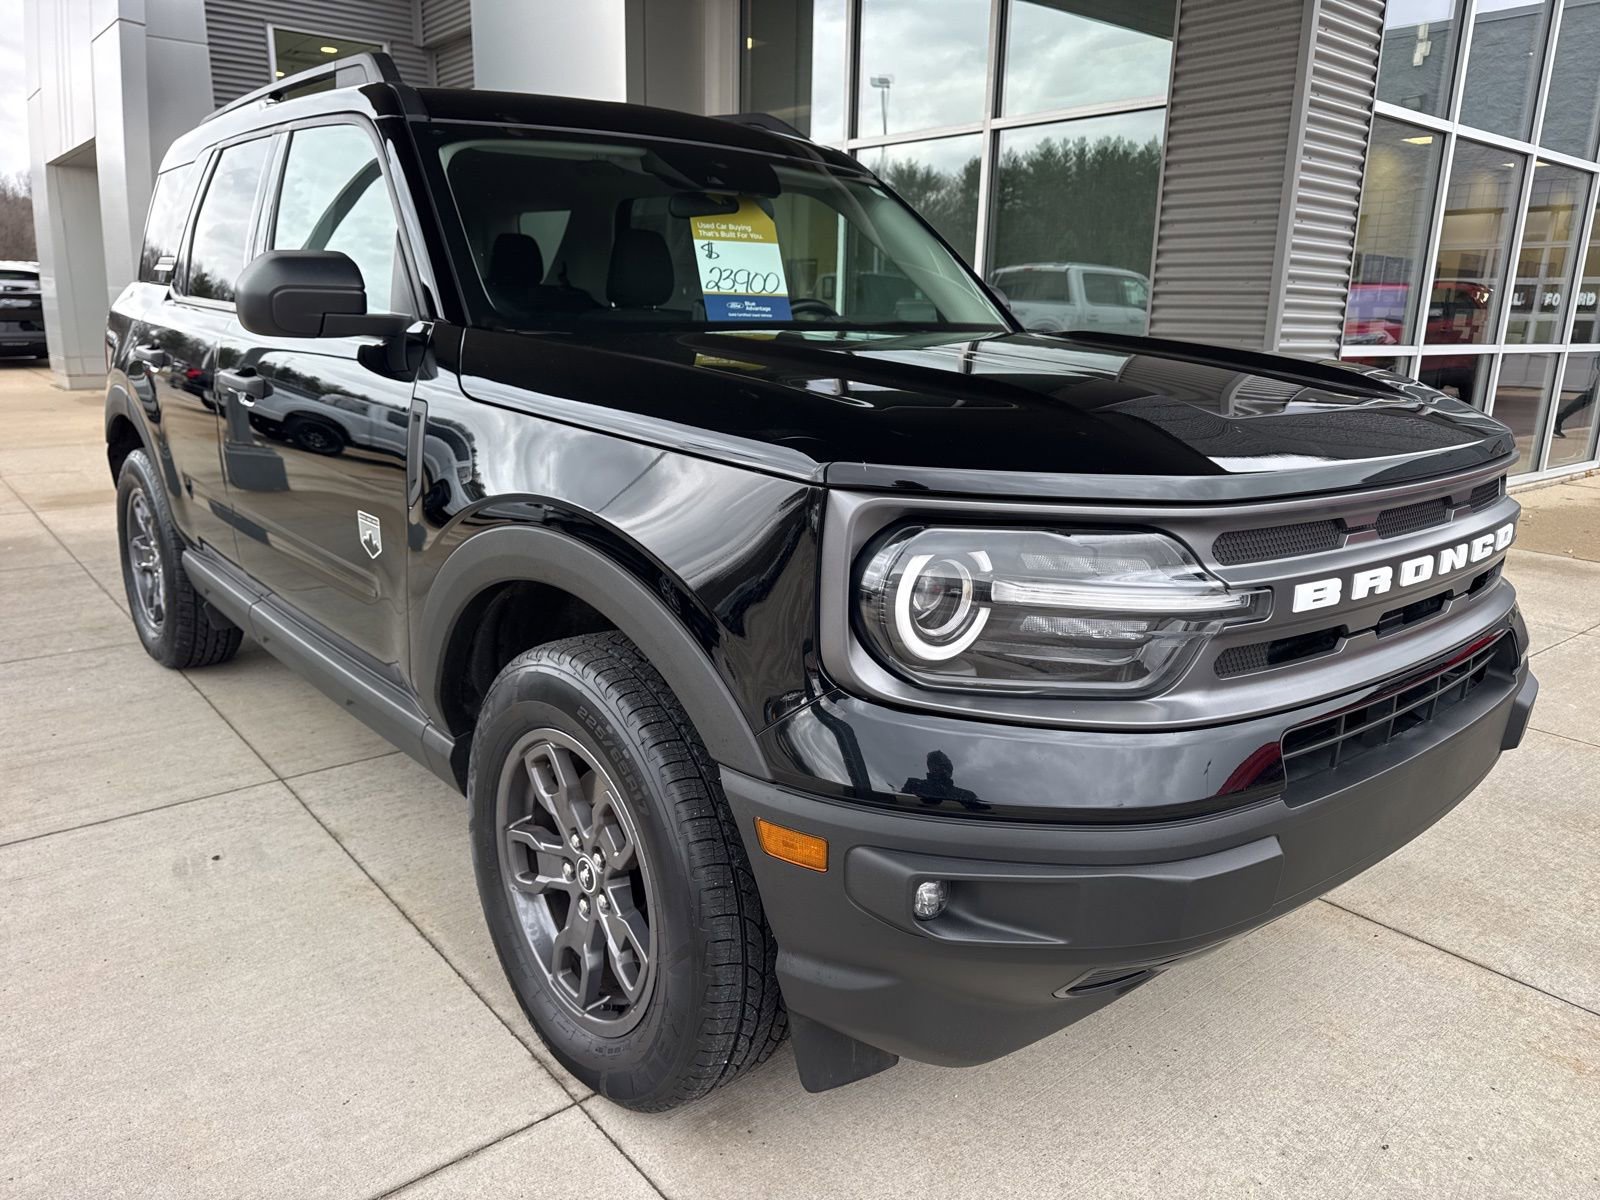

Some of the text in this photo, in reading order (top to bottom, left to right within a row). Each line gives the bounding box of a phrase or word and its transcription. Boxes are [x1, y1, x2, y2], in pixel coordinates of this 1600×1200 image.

[697, 222, 715, 230] Used
[729, 223, 752, 232] Buying
[698, 229, 719, 237] That's
[737, 231, 748, 239] For
[750, 232, 763, 240] You.
[700, 241, 720, 260] $
[1292, 522, 1514, 614] BRONCO
